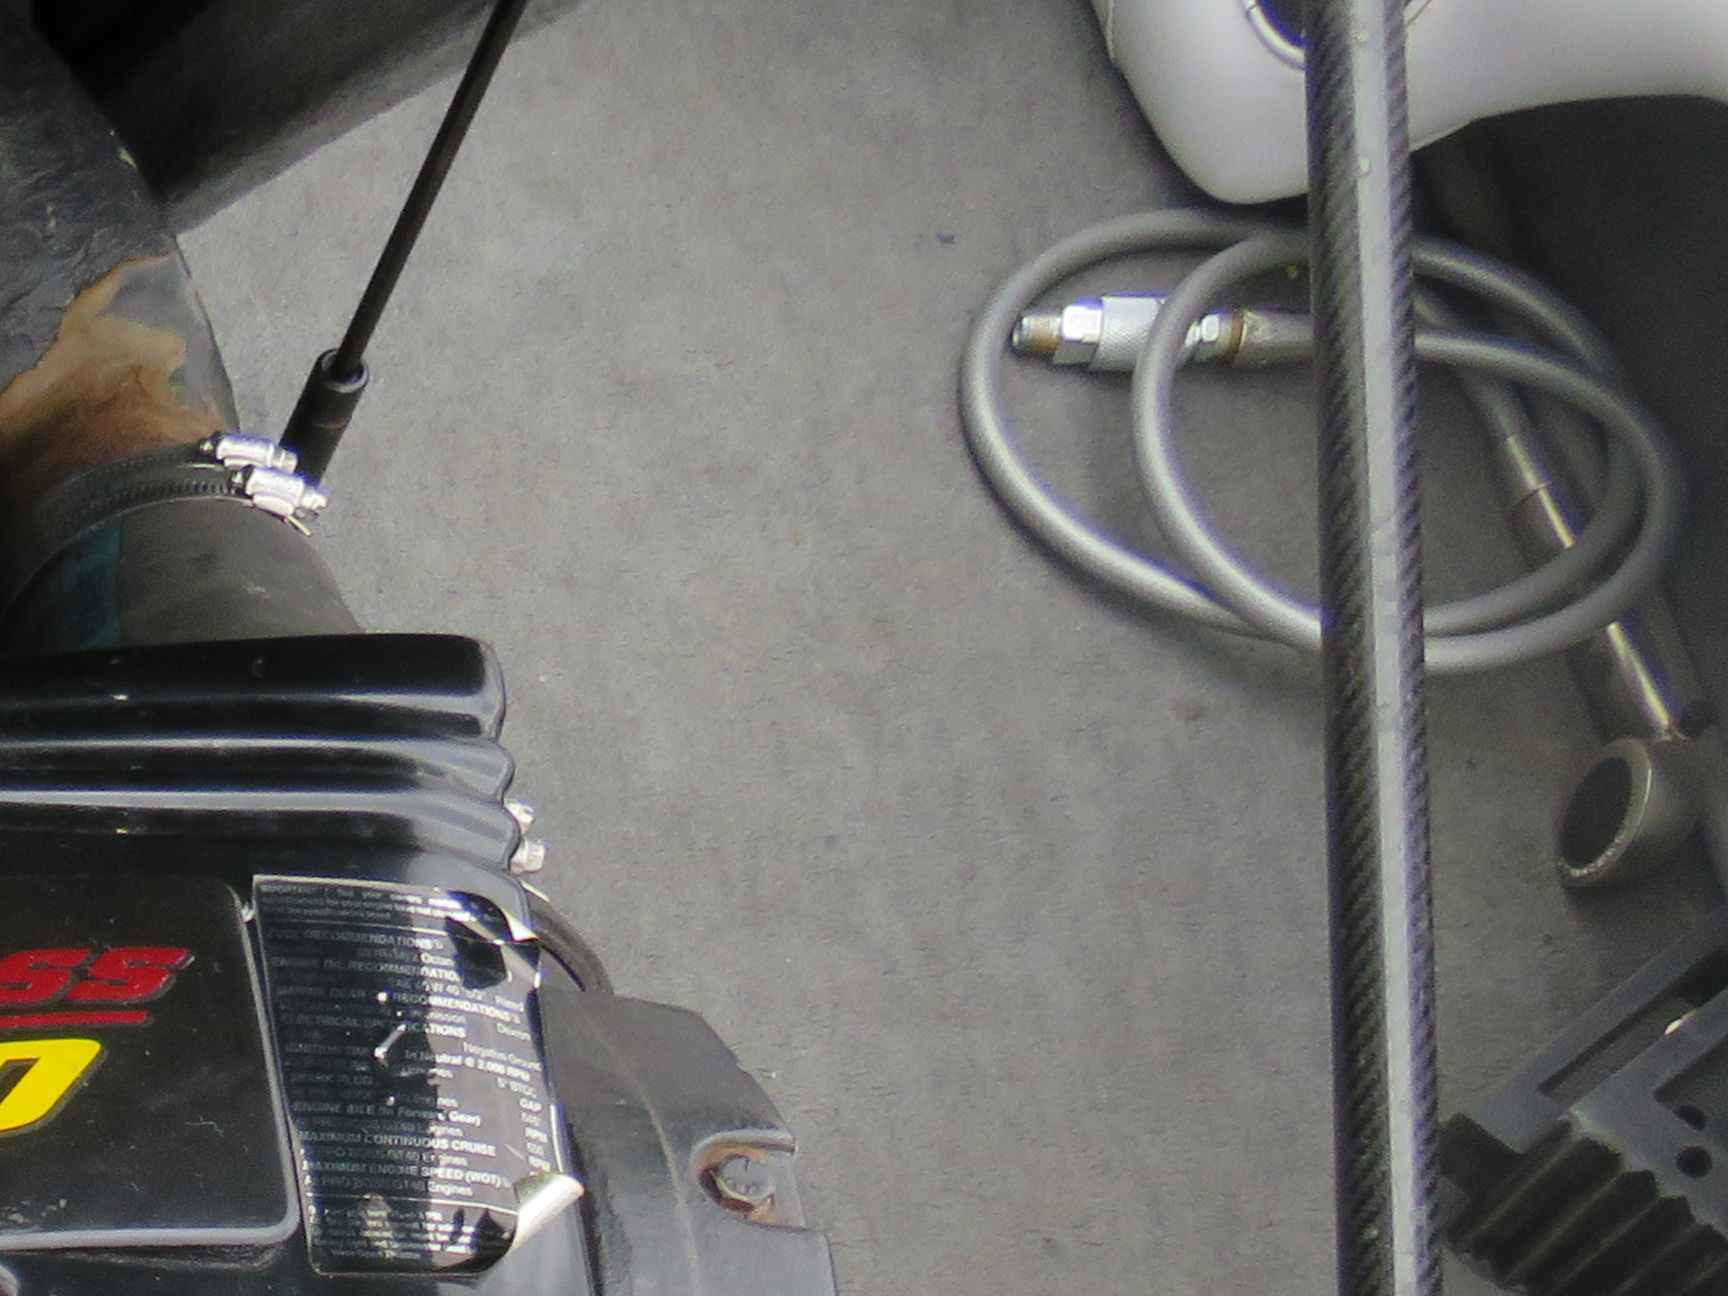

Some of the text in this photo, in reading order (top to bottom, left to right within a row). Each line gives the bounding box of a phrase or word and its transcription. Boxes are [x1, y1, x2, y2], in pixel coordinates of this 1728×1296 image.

[363, 1133, 449, 1150] CONTINUOUS
[450, 1137, 497, 1158] CRUISE
[419, 1165, 464, 1182] SPEED
[465, 1169, 503, 1189] (WOT)
[427, 1181, 474, 1197] Engines
